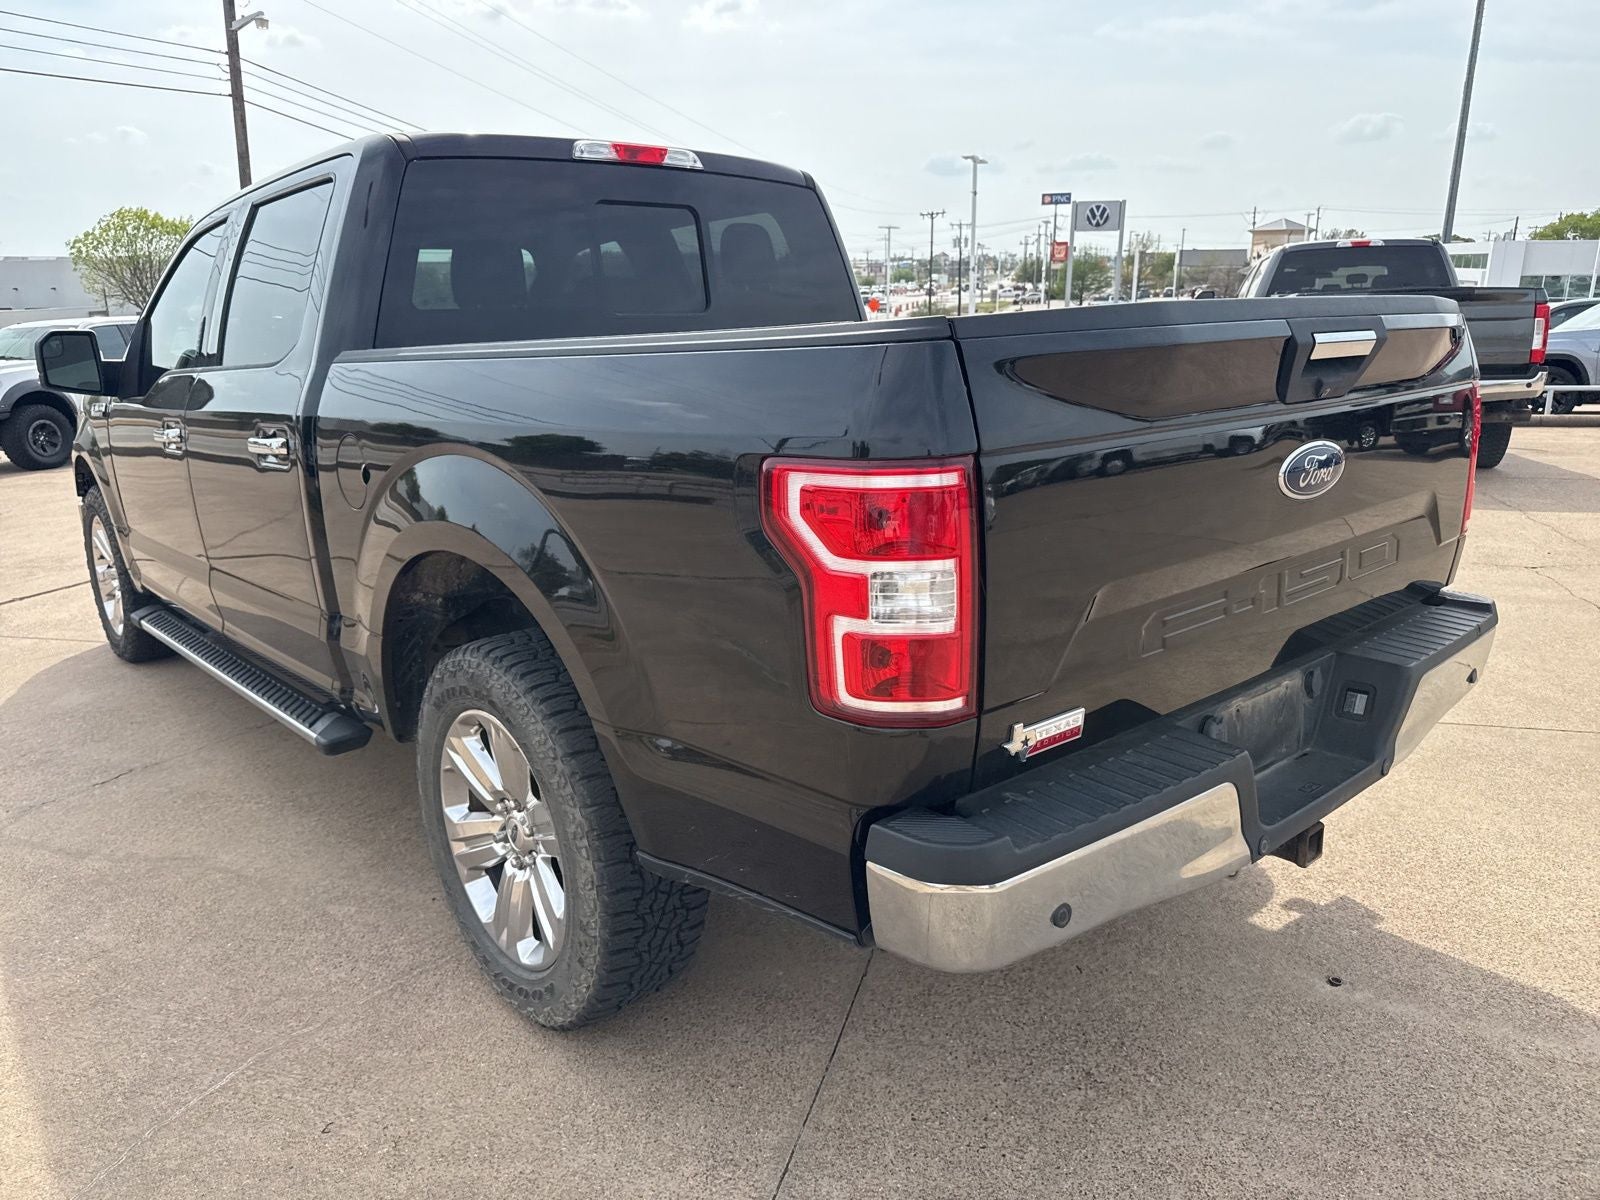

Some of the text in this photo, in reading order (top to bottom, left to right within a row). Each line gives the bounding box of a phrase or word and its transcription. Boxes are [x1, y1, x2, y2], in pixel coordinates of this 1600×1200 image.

[1052, 195, 1069, 203] PNC
[1299, 454, 1336, 488] Ford
[1036, 716, 1081, 737] TEXAS
[1036, 728, 1079, 747] EDITION
